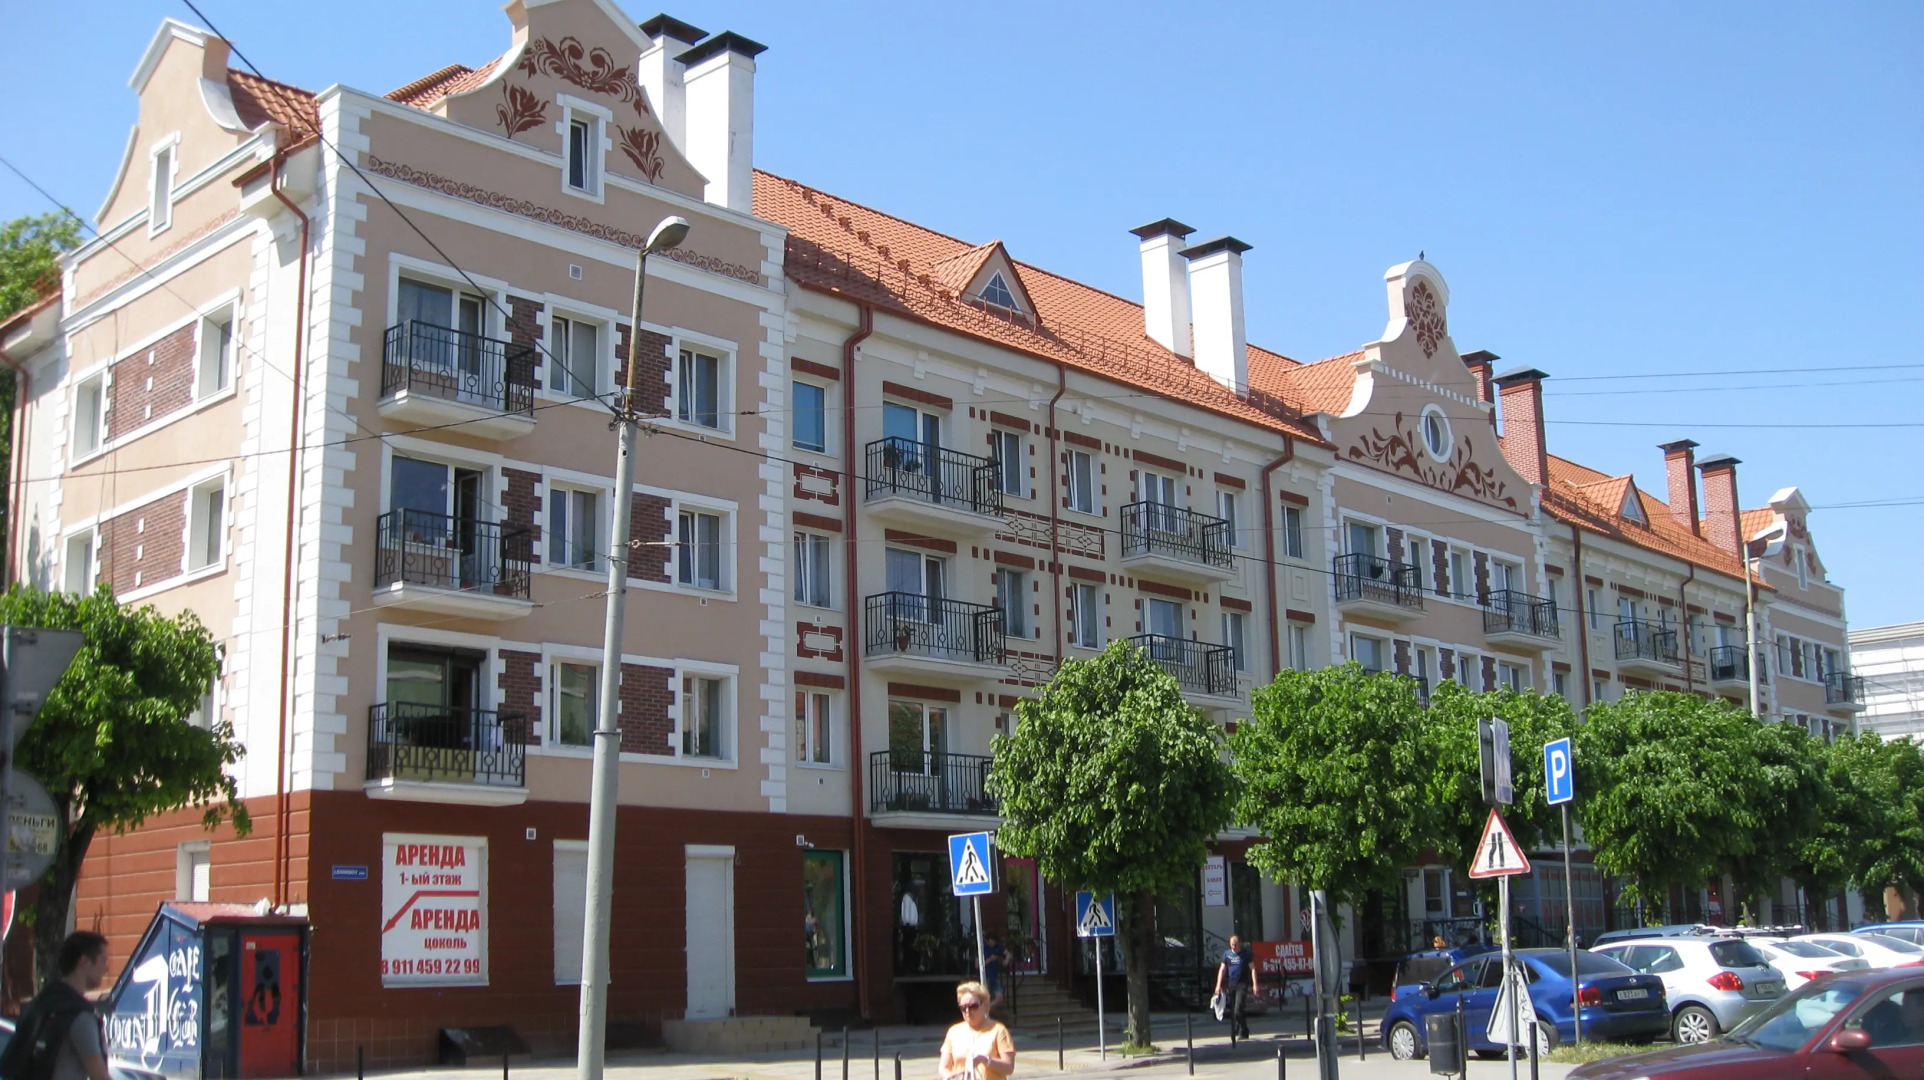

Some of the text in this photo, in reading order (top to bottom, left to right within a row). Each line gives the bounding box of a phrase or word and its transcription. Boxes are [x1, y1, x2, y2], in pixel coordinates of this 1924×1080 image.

[1551, 749, 1566, 796] P
[395, 844, 466, 869] АРЕНДА
[411, 871, 430, 885] ый
[432, 874, 462, 885] этаж
[411, 908, 480, 933] АРЕНДА
[424, 938, 467, 950] цоколь
[392, 959, 414, 974] 911
[416, 959, 442, 974] 459
[445, 959, 461, 974] 22
[463, 959, 480, 973] 99
